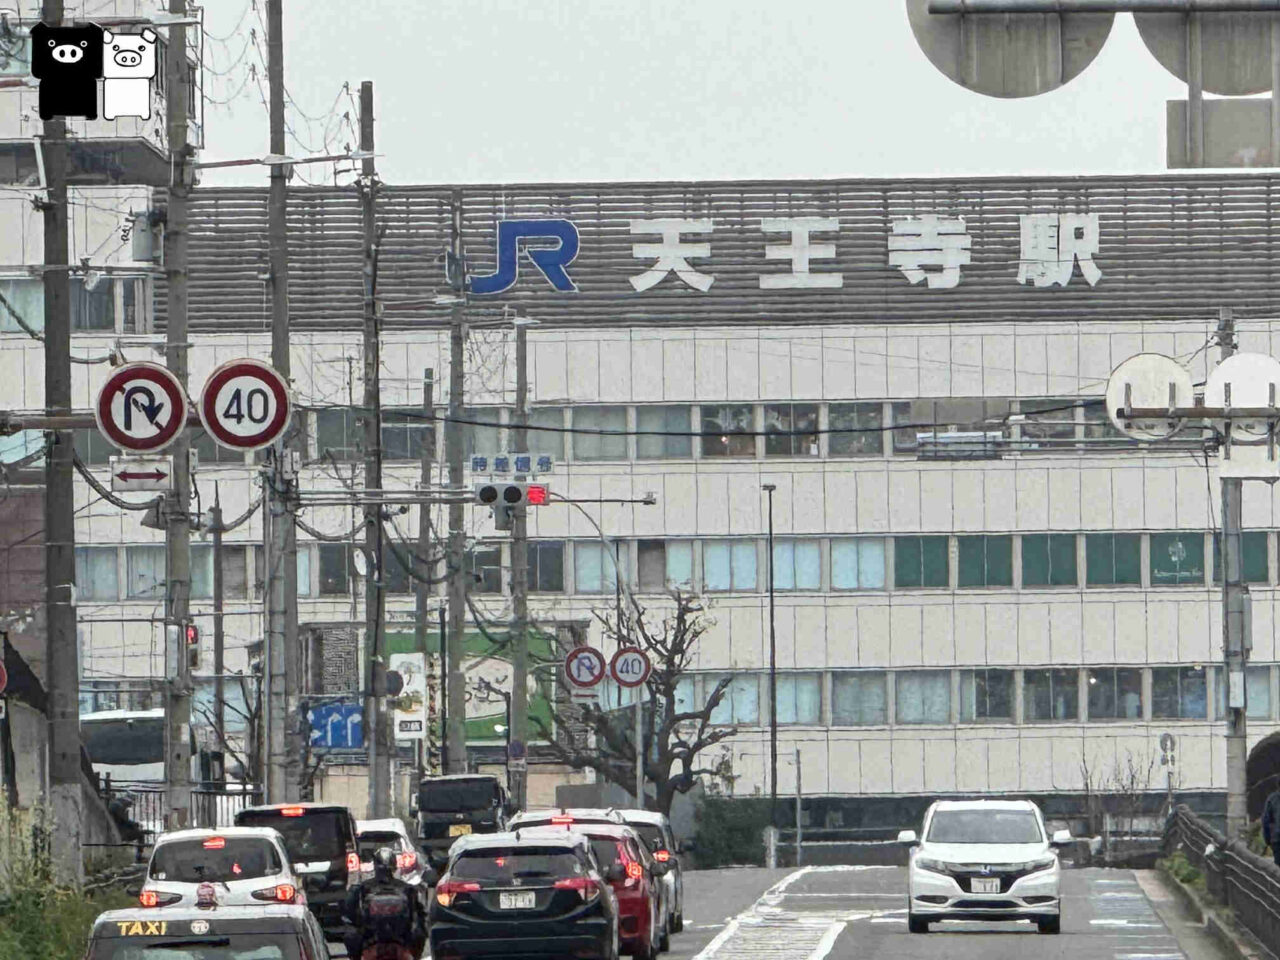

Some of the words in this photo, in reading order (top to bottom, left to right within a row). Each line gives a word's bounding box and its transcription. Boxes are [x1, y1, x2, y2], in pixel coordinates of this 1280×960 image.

[463, 218, 580, 295] JR
[629, 213, 1102, 292] 天王寺駅
[223, 388, 269, 424] 40
[619, 658, 642, 675] 40
[117, 920, 168, 936] TAXI
